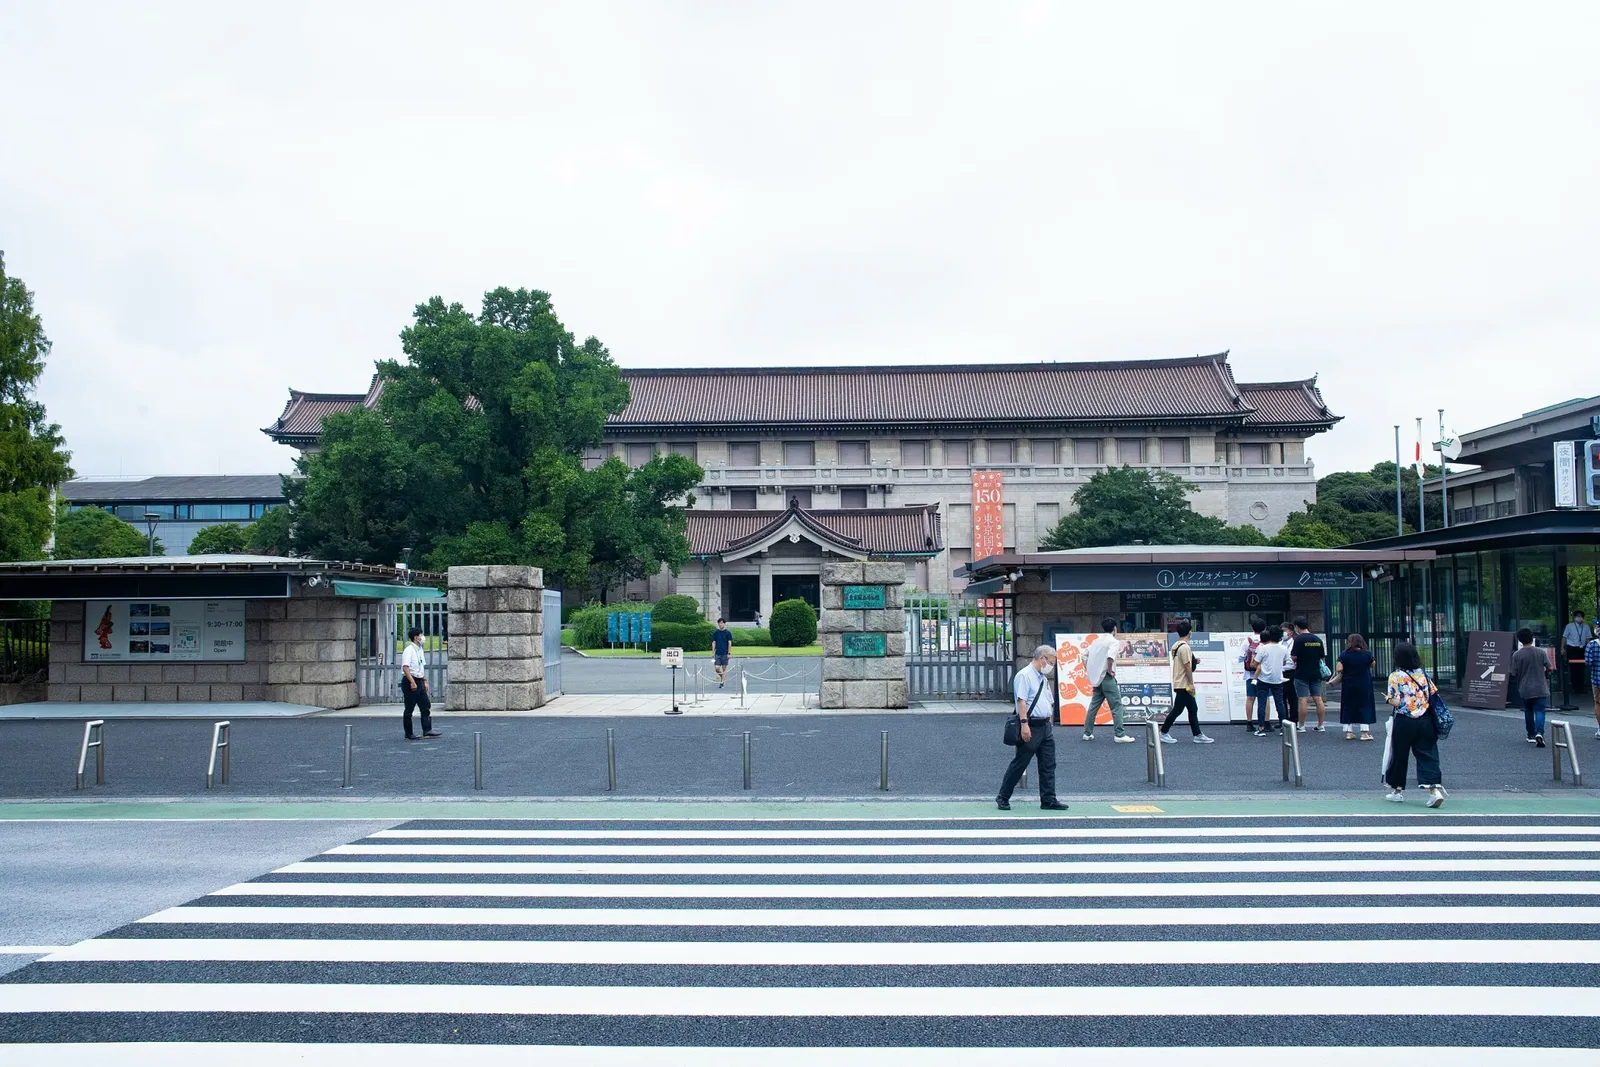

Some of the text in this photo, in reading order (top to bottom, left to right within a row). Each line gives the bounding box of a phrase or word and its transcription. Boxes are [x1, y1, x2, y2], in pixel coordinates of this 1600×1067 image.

[976, 489, 1001, 504] 150
[983, 513, 994, 557] 東京国立
[1178, 570, 1258, 580] インフォメーション
